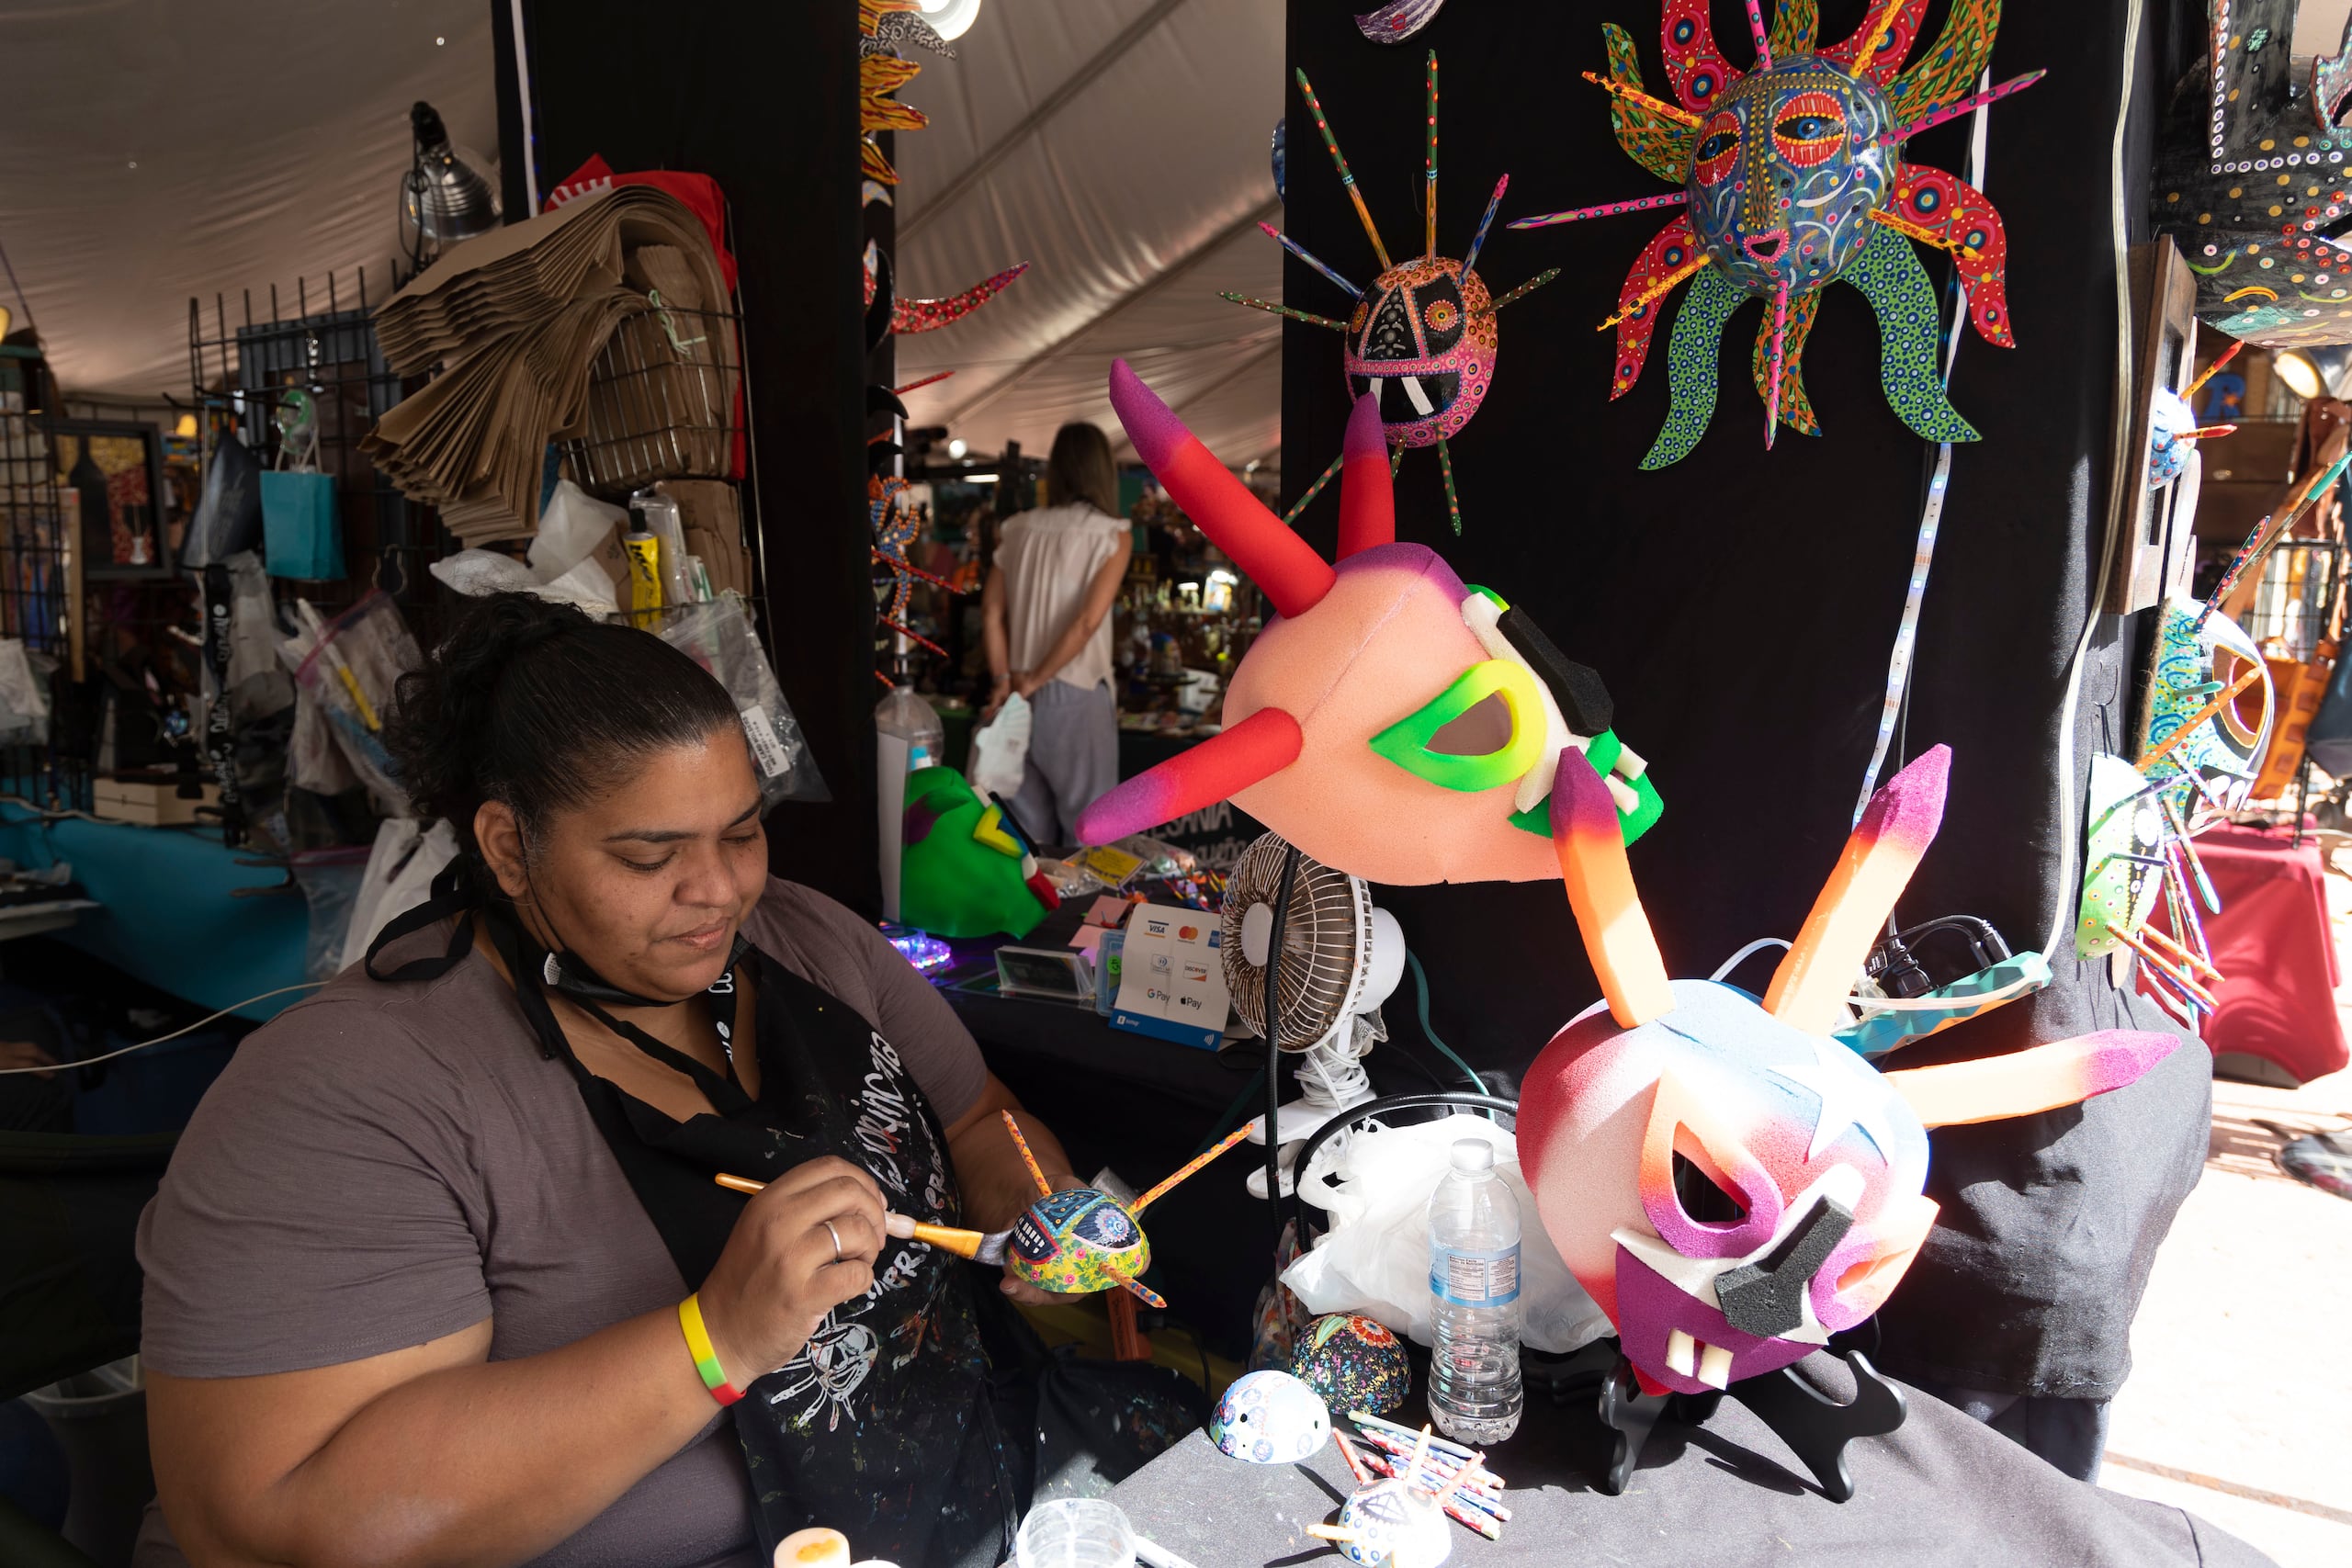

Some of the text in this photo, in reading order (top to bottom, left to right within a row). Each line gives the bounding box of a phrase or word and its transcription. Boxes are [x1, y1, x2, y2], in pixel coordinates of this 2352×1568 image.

[1148, 924, 1165, 934] VISA
[1156, 989, 1170, 1007] Pay
[1186, 998, 1202, 1010] Pay
